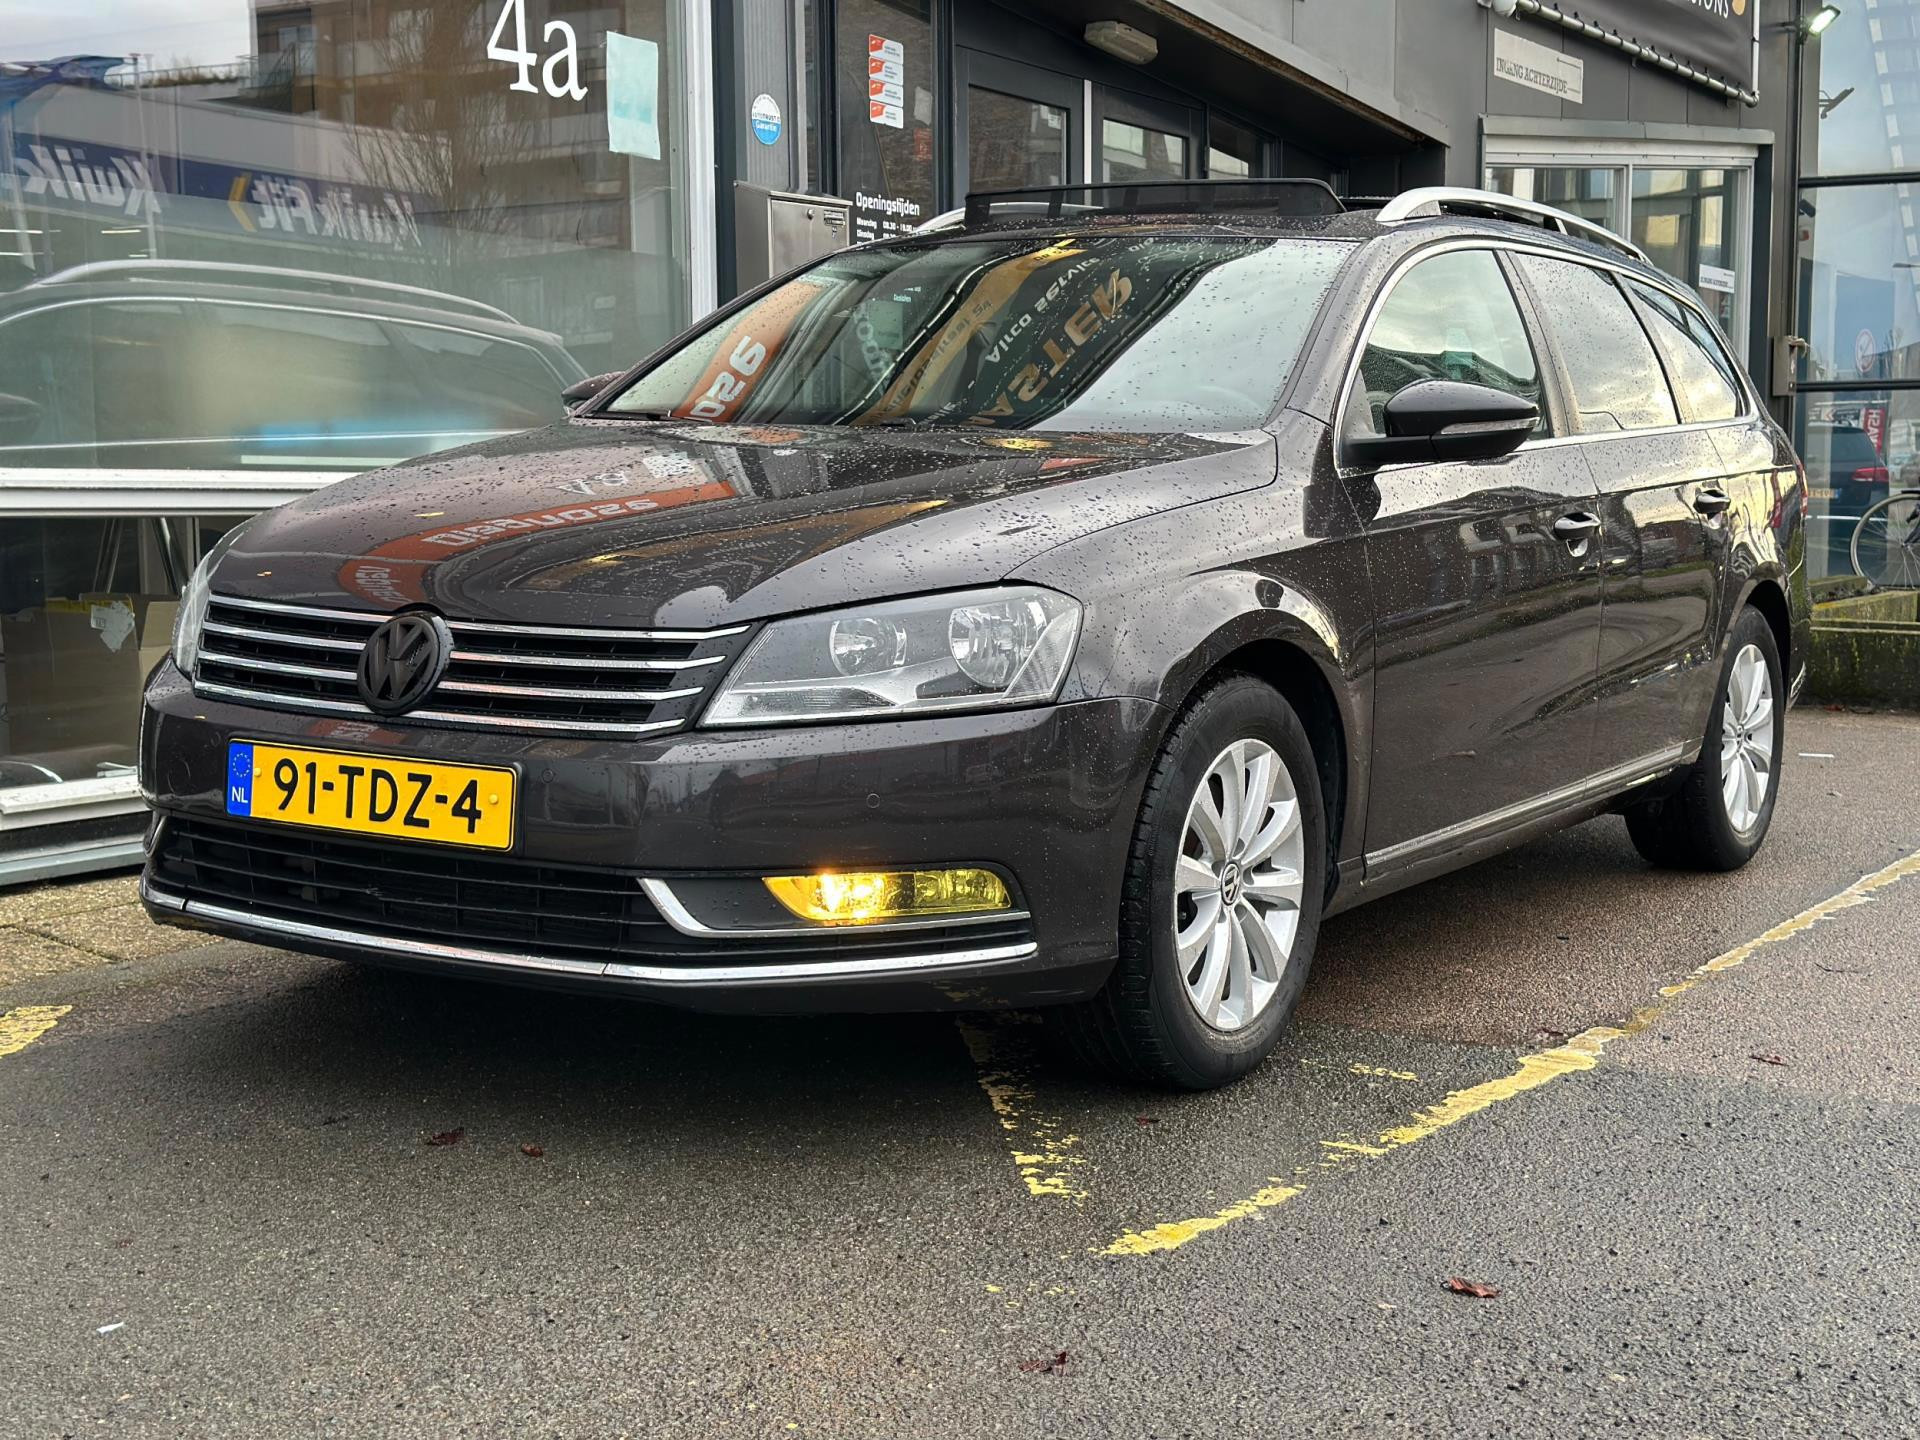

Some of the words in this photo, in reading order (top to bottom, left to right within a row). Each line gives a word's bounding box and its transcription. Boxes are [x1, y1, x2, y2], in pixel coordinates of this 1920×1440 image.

[487, 0, 588, 101] 4a
[856, 191, 920, 216] Openingstijden
[231, 786, 249, 804] NL
[274, 757, 482, 834] 91-TDZ-4
